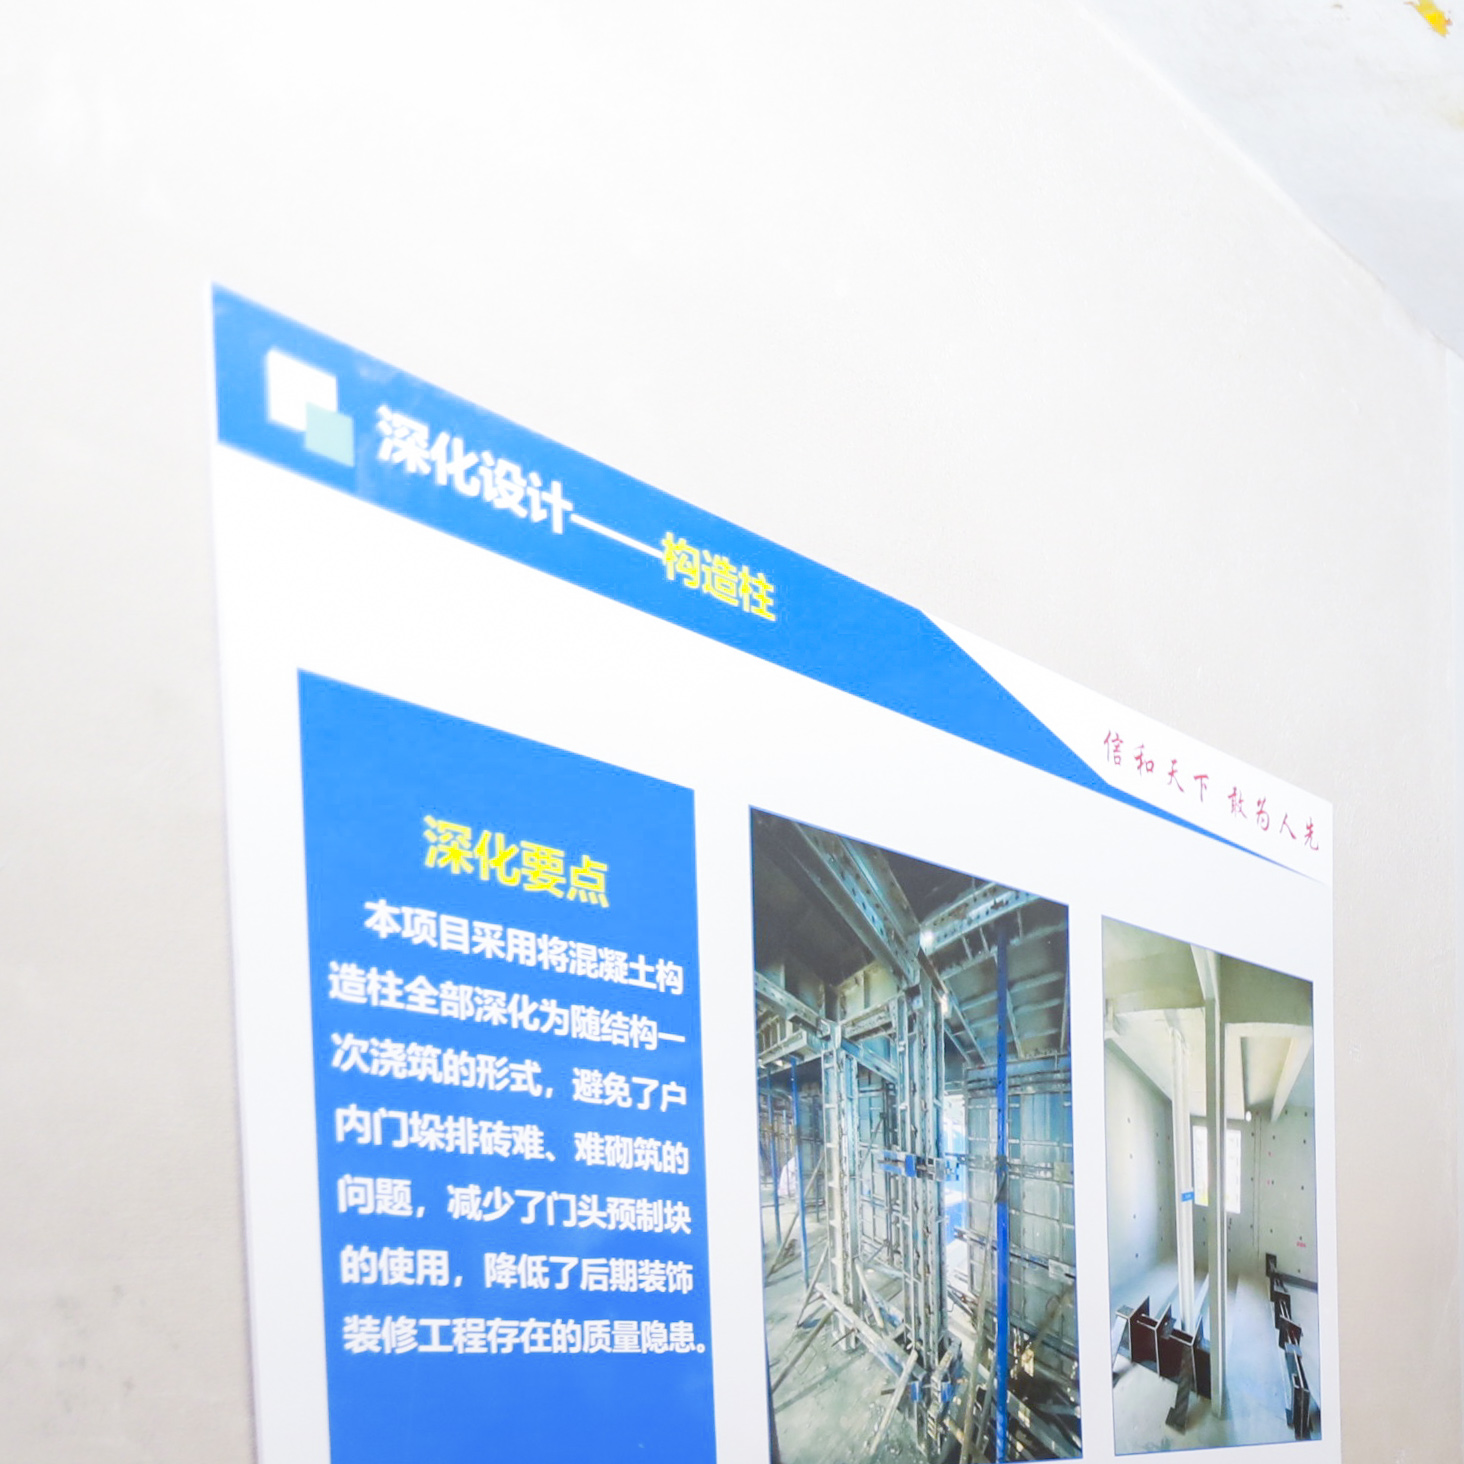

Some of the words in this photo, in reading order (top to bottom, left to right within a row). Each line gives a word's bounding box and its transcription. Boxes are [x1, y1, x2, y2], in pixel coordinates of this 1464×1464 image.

[1104, 730, 1209, 803] 信和天下
[1227, 787, 1319, 851] 敢为人先
[423, 814, 610, 908] 深化要点
[364, 899, 684, 995] 本项目采用将混凝土构
[328, 960, 685, 1051] 造柱全部深化为随结构一
[330, 1033, 687, 1112] 次浇筑的形式，避免了户
[334, 1104, 689, 1175] 内门垛排砖难、难砌筑的
[337, 1175, 691, 1234] 问题，减少了门头预制块
[340, 1245, 693, 1294] 的使用，降低了后期装饰
[342, 1315, 706, 1355] 装修工程存在的质量隐患。
